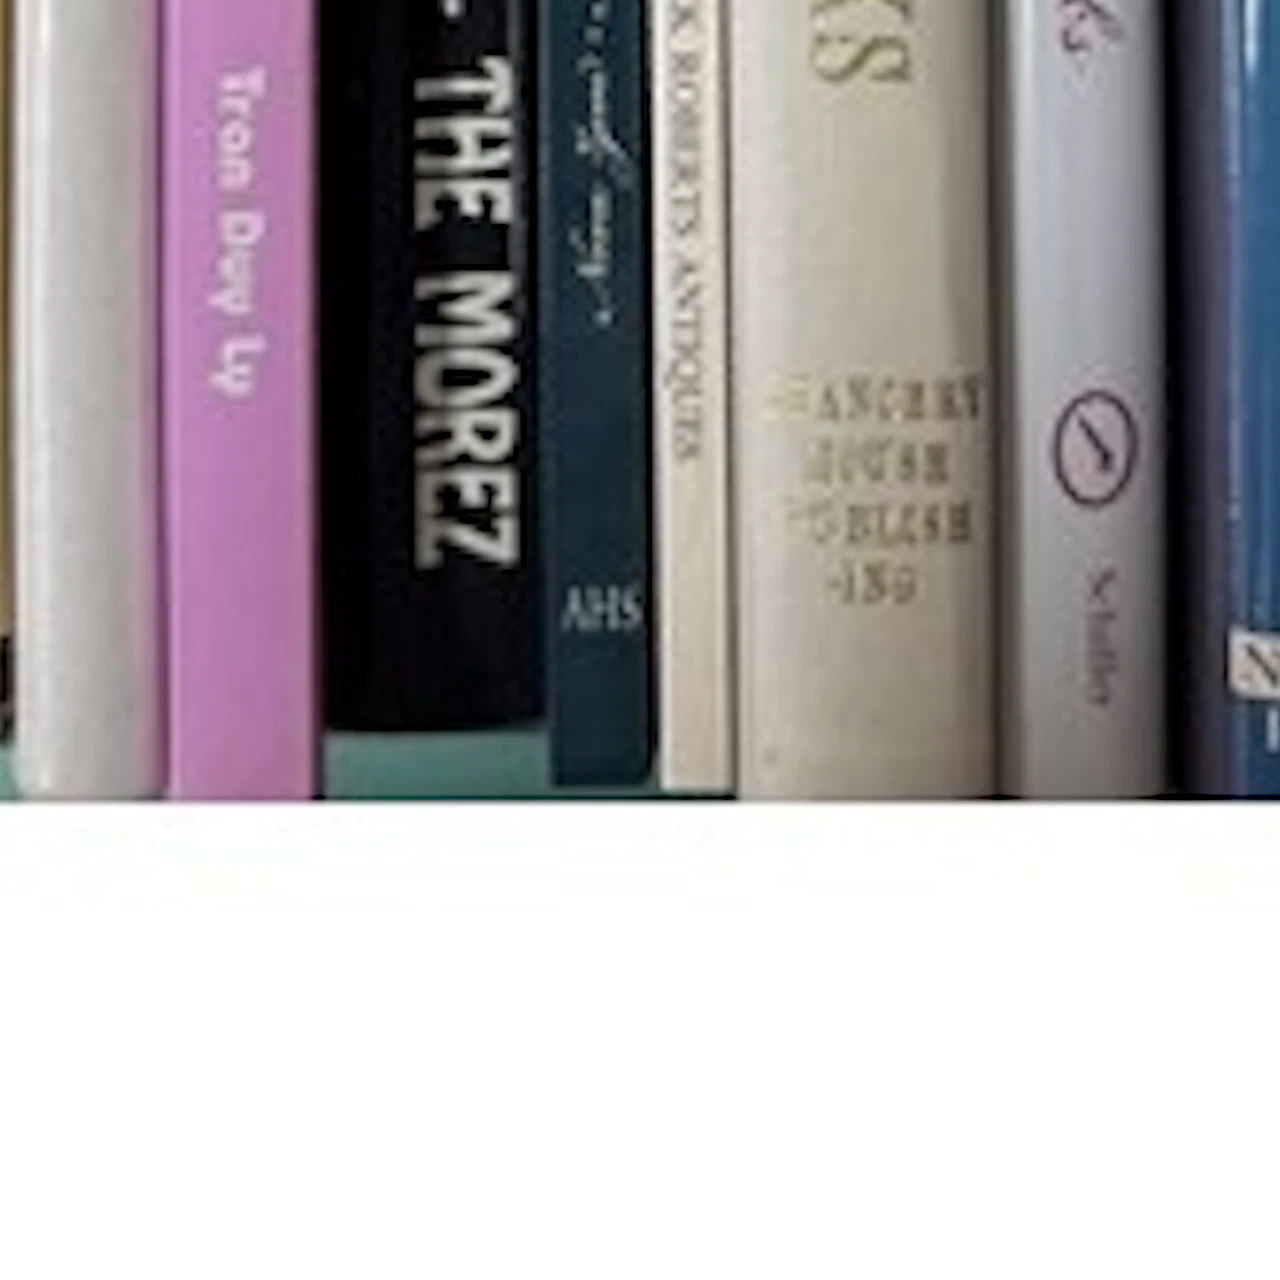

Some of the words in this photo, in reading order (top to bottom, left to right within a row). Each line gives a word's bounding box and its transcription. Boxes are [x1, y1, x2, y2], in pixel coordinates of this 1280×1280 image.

[218, 65, 265, 191] Tran
[414, 53, 515, 231] THE
[413, 269, 520, 571] MOREZ
[562, 584, 642, 632] AHS
